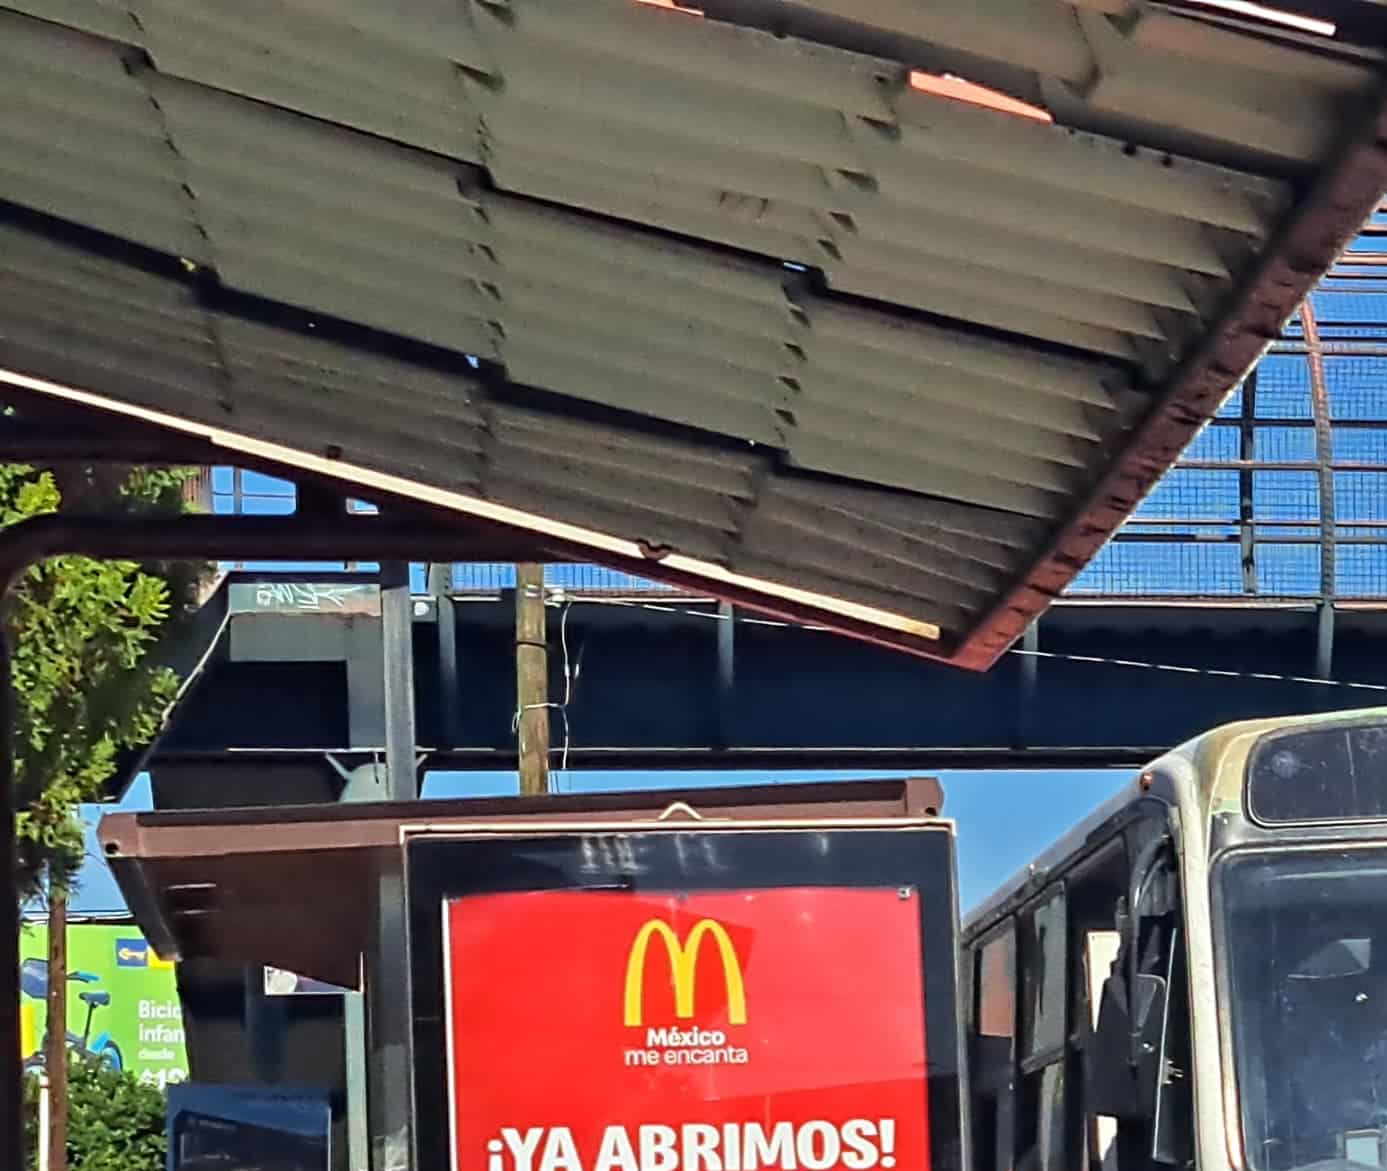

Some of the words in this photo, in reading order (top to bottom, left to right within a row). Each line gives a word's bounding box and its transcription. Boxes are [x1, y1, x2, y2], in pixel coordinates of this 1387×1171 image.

[646, 1027, 726, 1047] México
[625, 1049, 660, 1066] me
[663, 1046, 749, 1065] encanta
